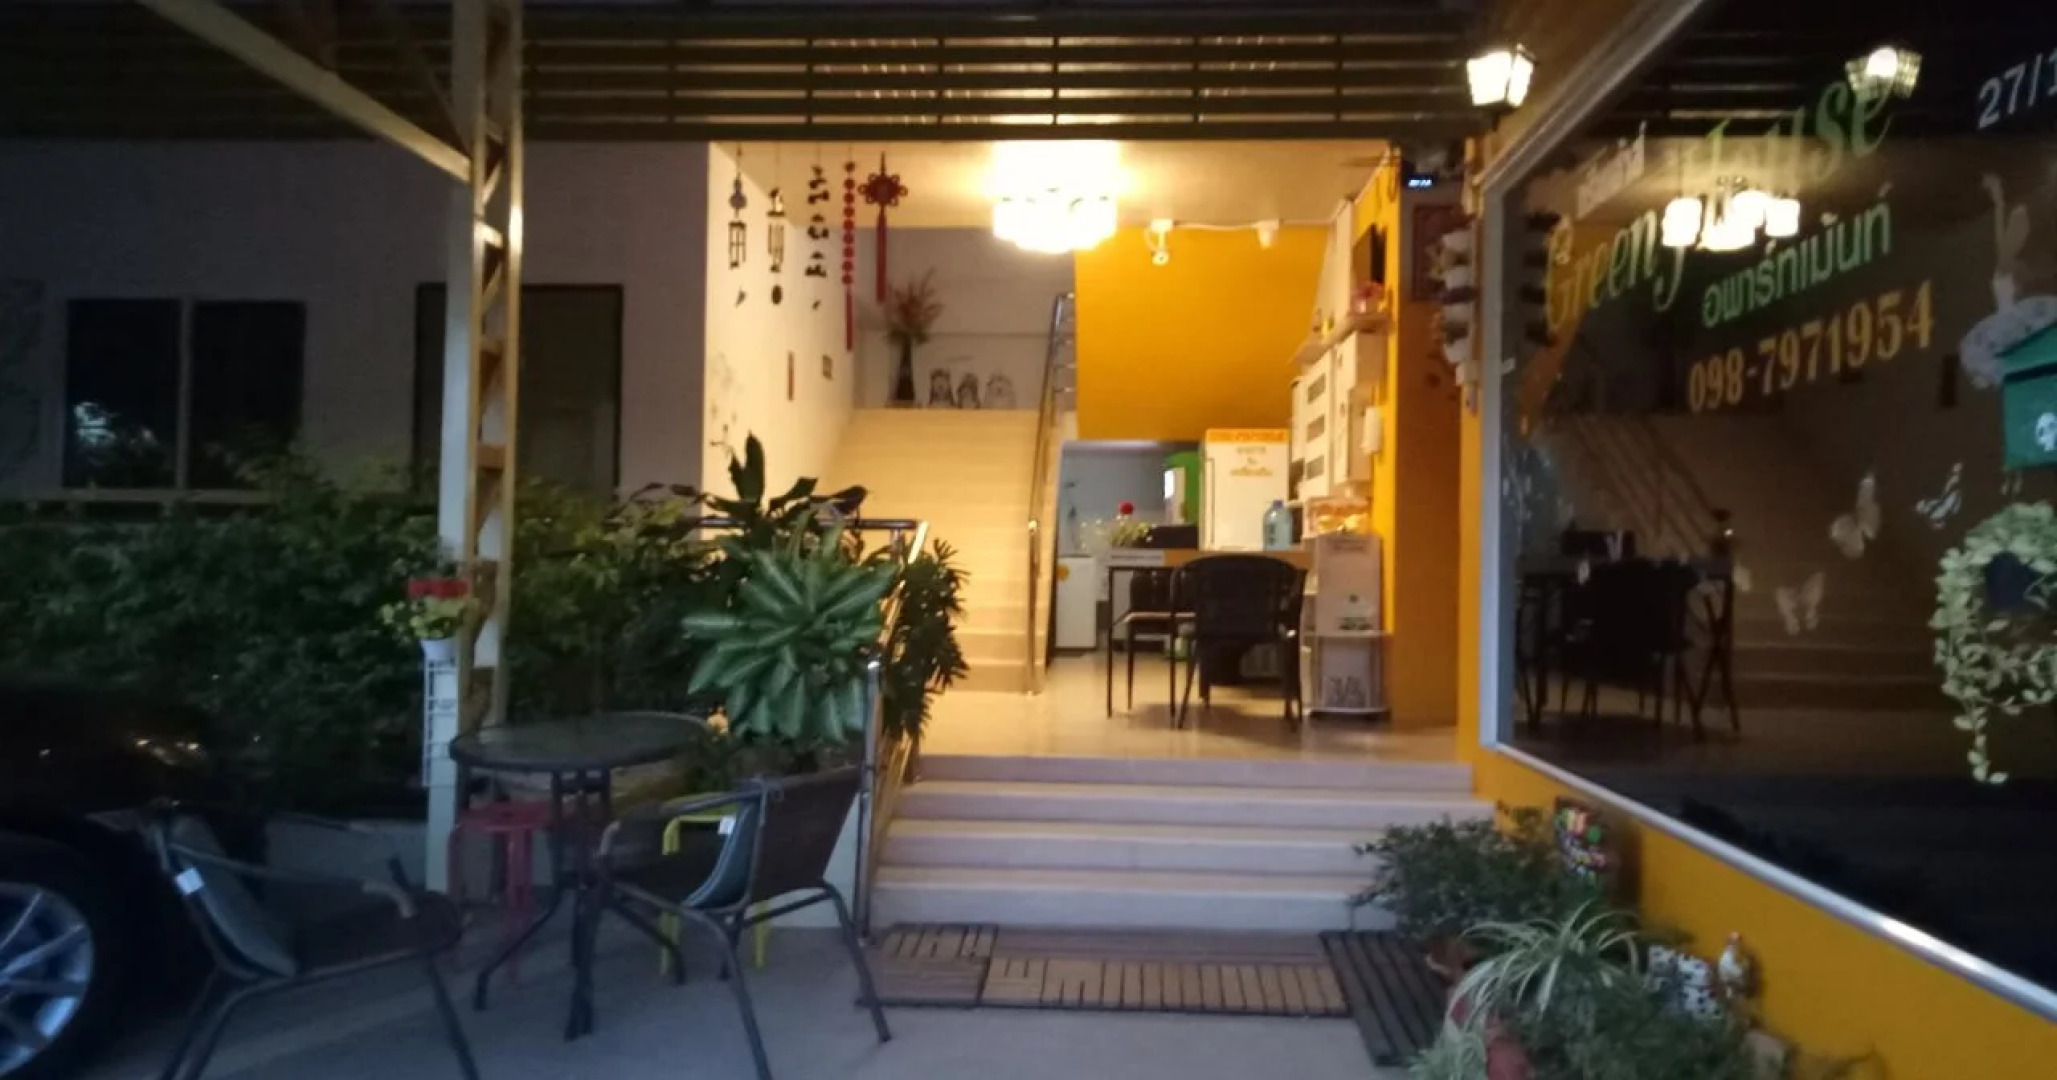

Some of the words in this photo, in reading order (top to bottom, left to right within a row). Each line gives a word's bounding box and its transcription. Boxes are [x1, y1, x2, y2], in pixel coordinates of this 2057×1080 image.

[1545, 210, 1658, 333] Green
[1653, 66, 1894, 312] Huse
[1688, 279, 1935, 413] 098-7971954
